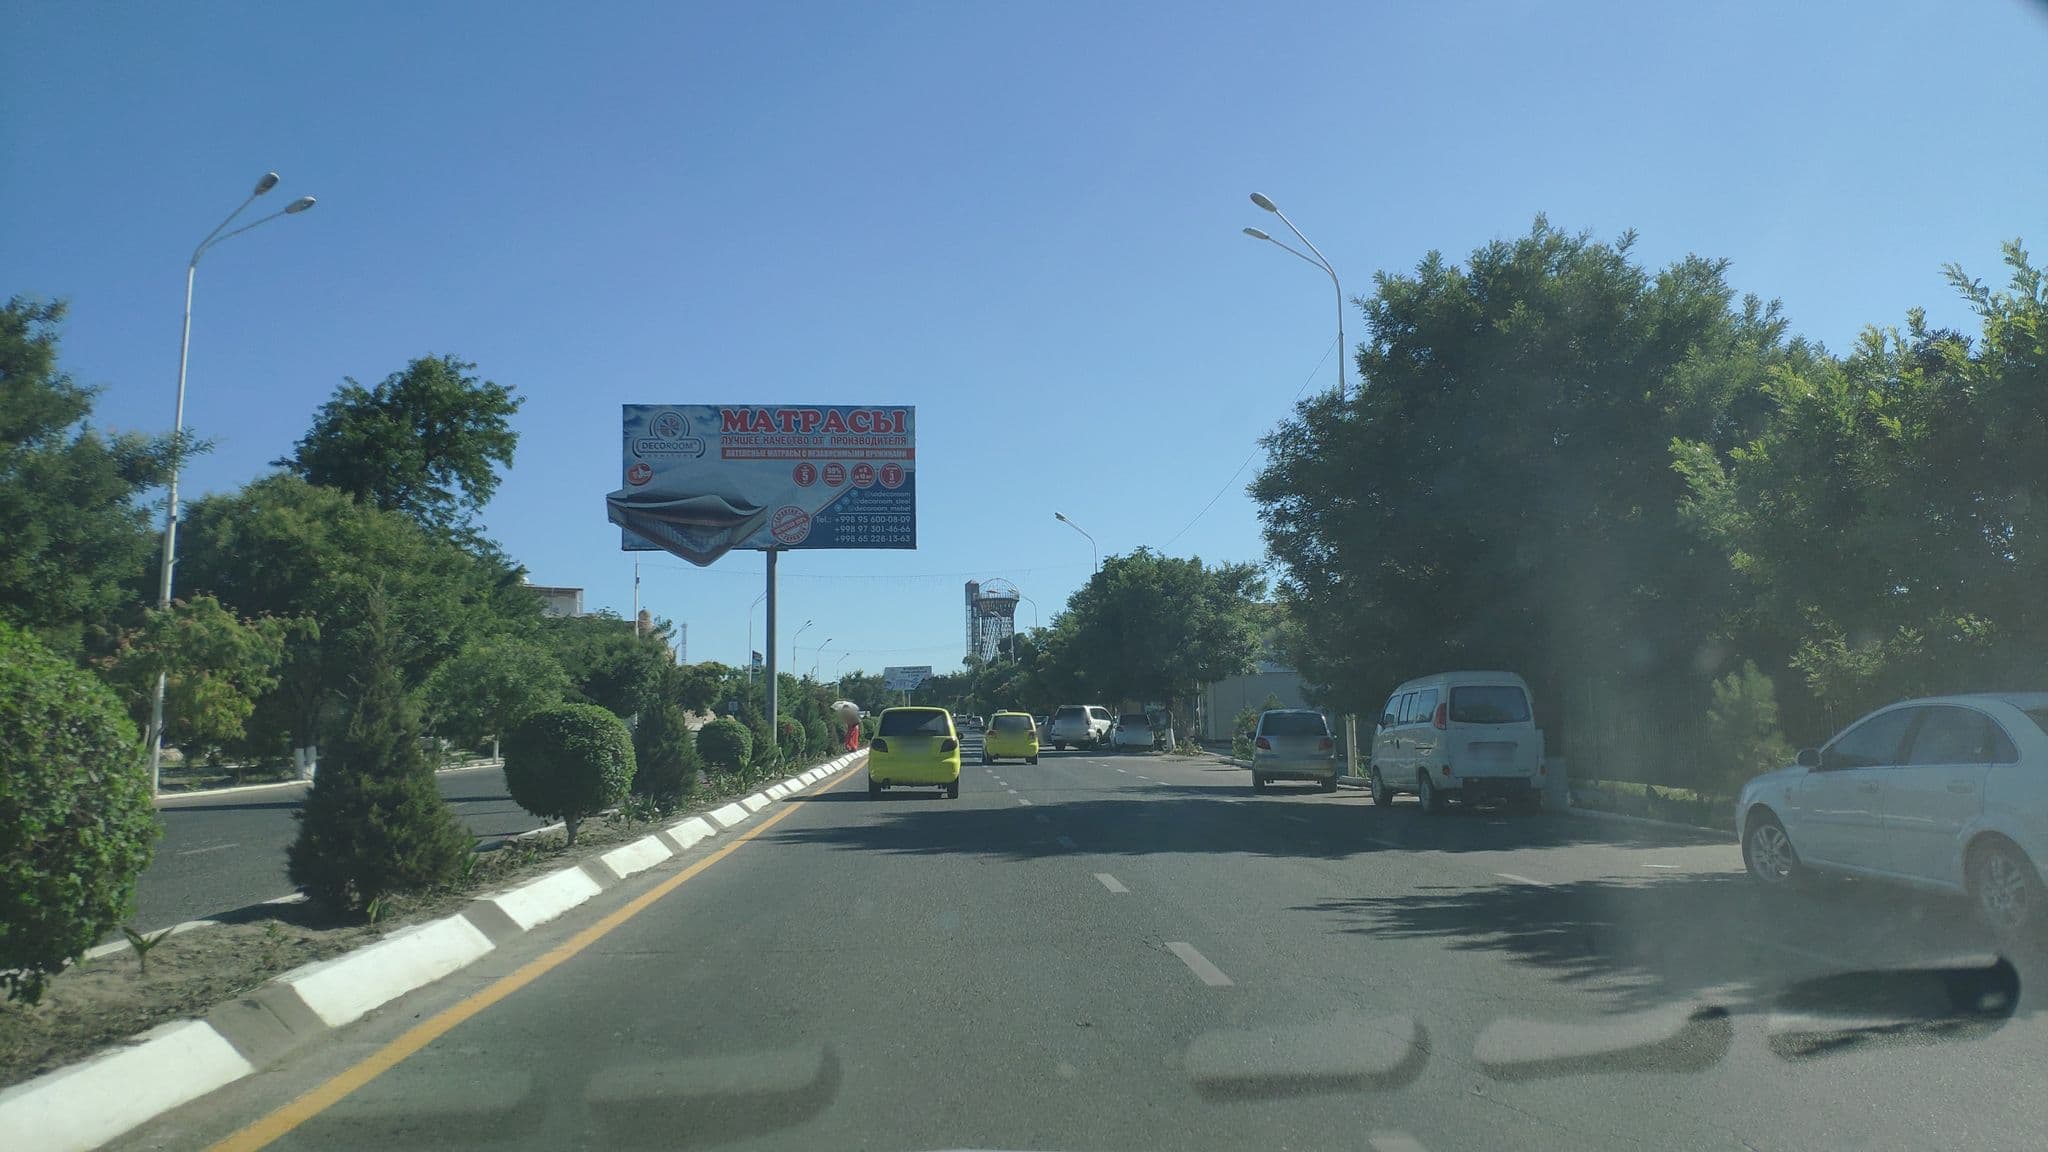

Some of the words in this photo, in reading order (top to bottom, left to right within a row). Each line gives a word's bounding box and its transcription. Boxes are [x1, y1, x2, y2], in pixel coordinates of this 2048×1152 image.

[721, 409, 906, 433] МАТРАСЫ
[722, 436, 760, 445] ЛУЧШЕЕ
[764, 436, 809, 445] КАЧЕСТВО
[812, 436, 824, 445] ОТ
[830, 436, 907, 446] ПРОИЗВОДИТЕЛЯ
[641, 442, 693, 450] DECOROOM
[834, 525, 856, 533] +998
[857, 525, 868, 533] 97
